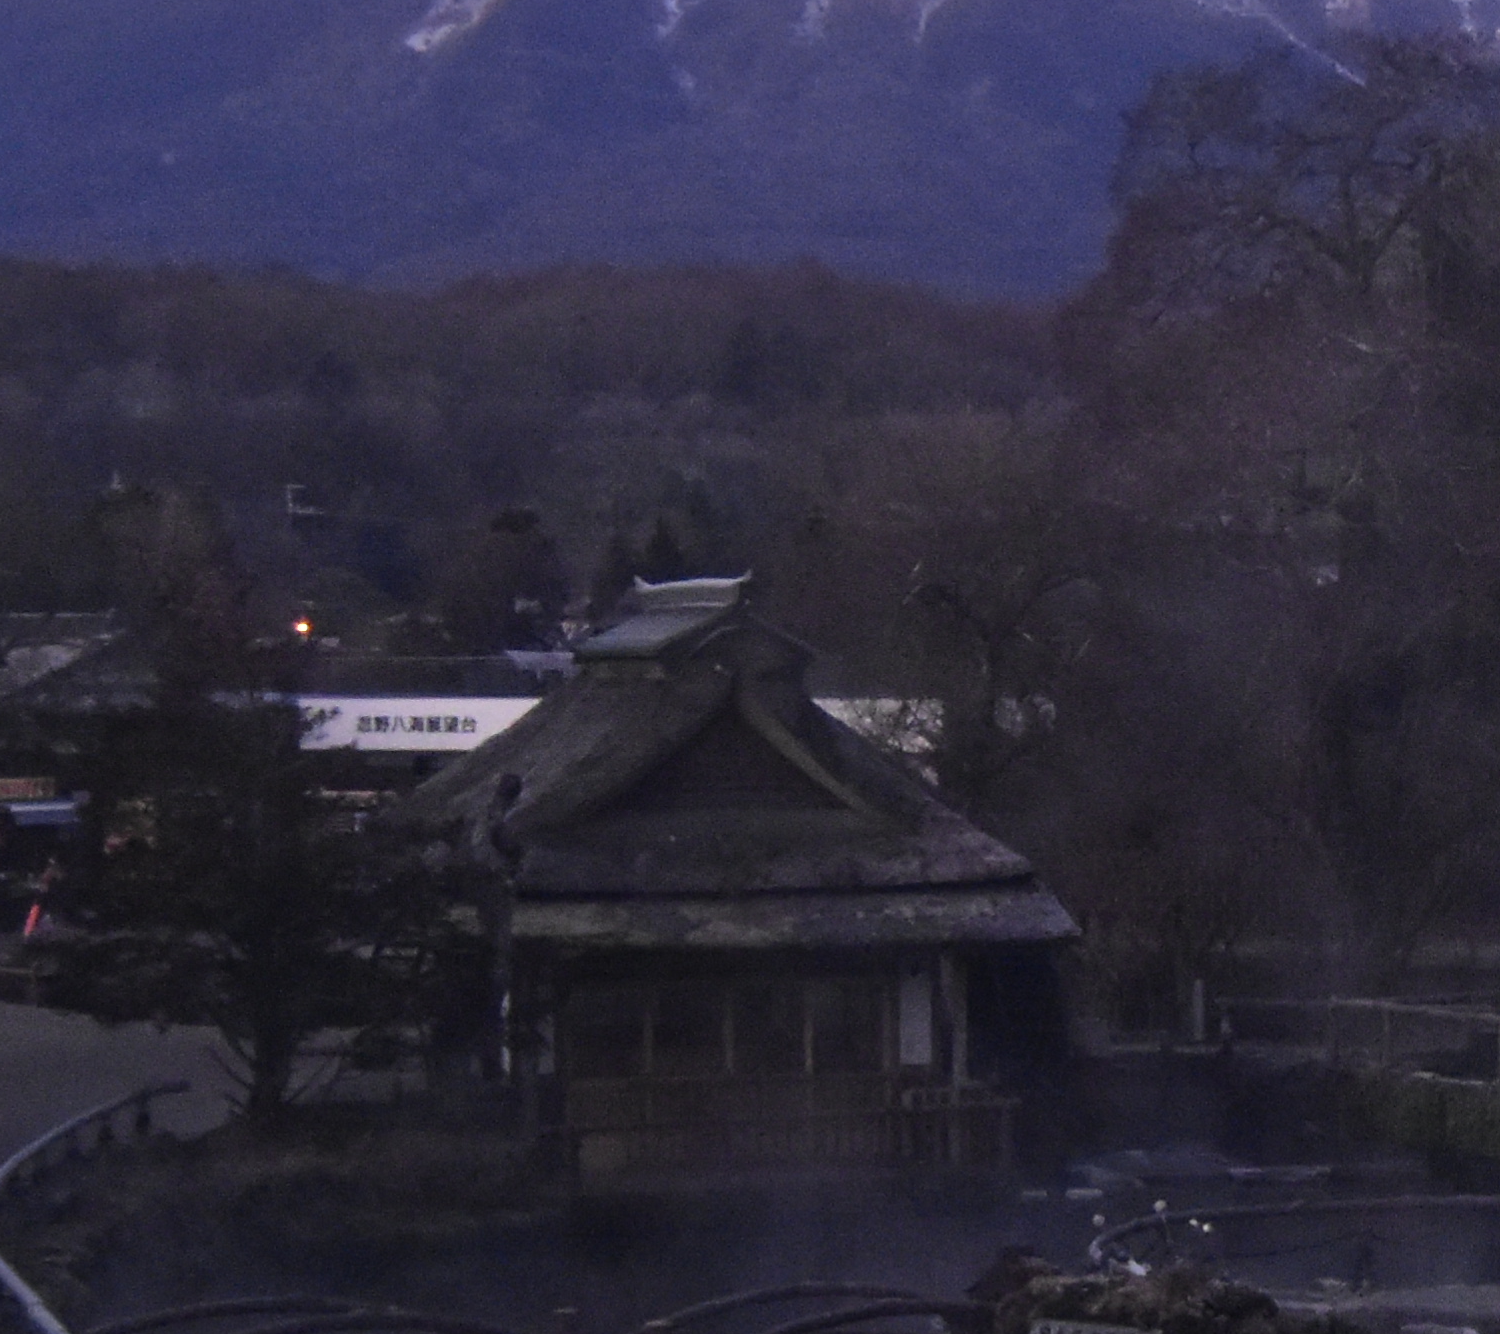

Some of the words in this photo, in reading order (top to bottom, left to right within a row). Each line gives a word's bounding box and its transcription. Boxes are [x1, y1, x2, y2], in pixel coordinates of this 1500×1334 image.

[356, 715, 477, 733] 忍野八海展望台
